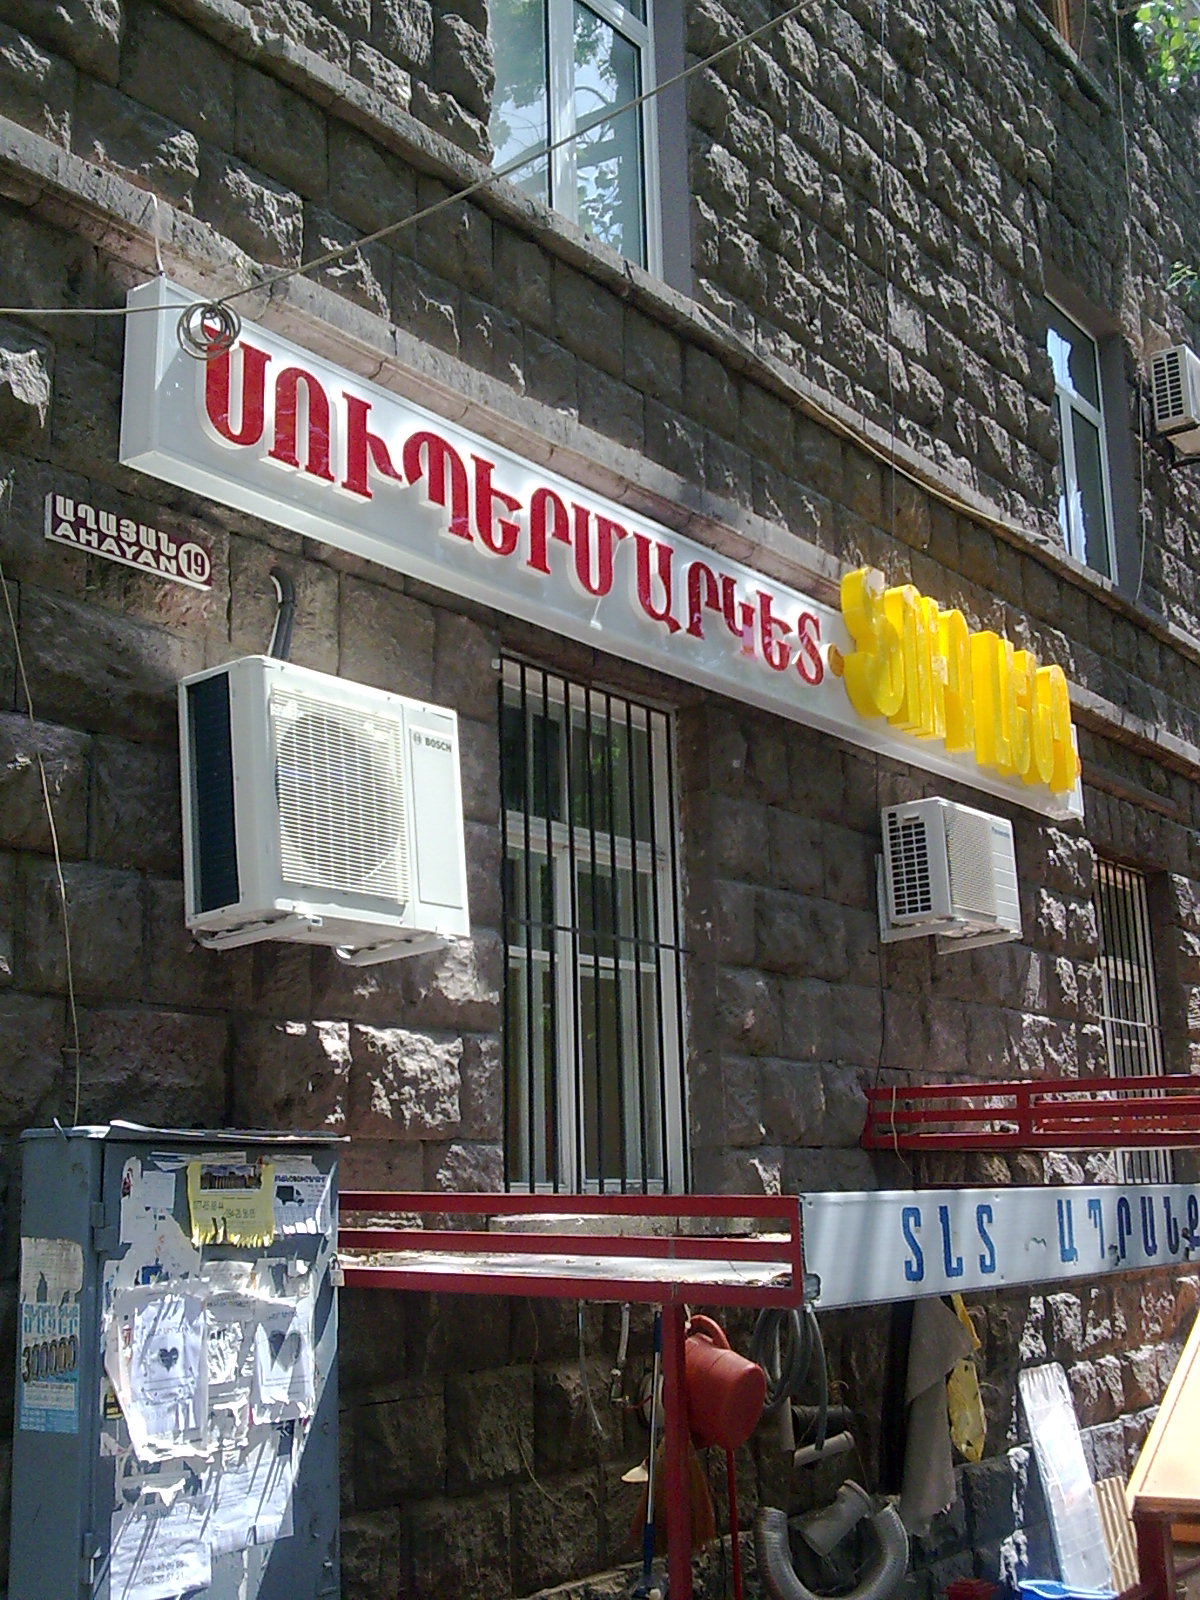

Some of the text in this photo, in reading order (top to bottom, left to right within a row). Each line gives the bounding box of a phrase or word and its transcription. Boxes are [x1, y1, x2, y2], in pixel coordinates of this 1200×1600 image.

[55, 494, 177, 557] ԱՂԱՅԱՆ
[203, 322, 825, 687] ՍՈՒՊԵՐՄԱՐԿԵՏ
[55, 521, 177, 575] AHAYAN
[425, 737, 452, 753] BOSCH
[1057, 1194, 1200, 1263] ԱՊՐԱՆՔ
